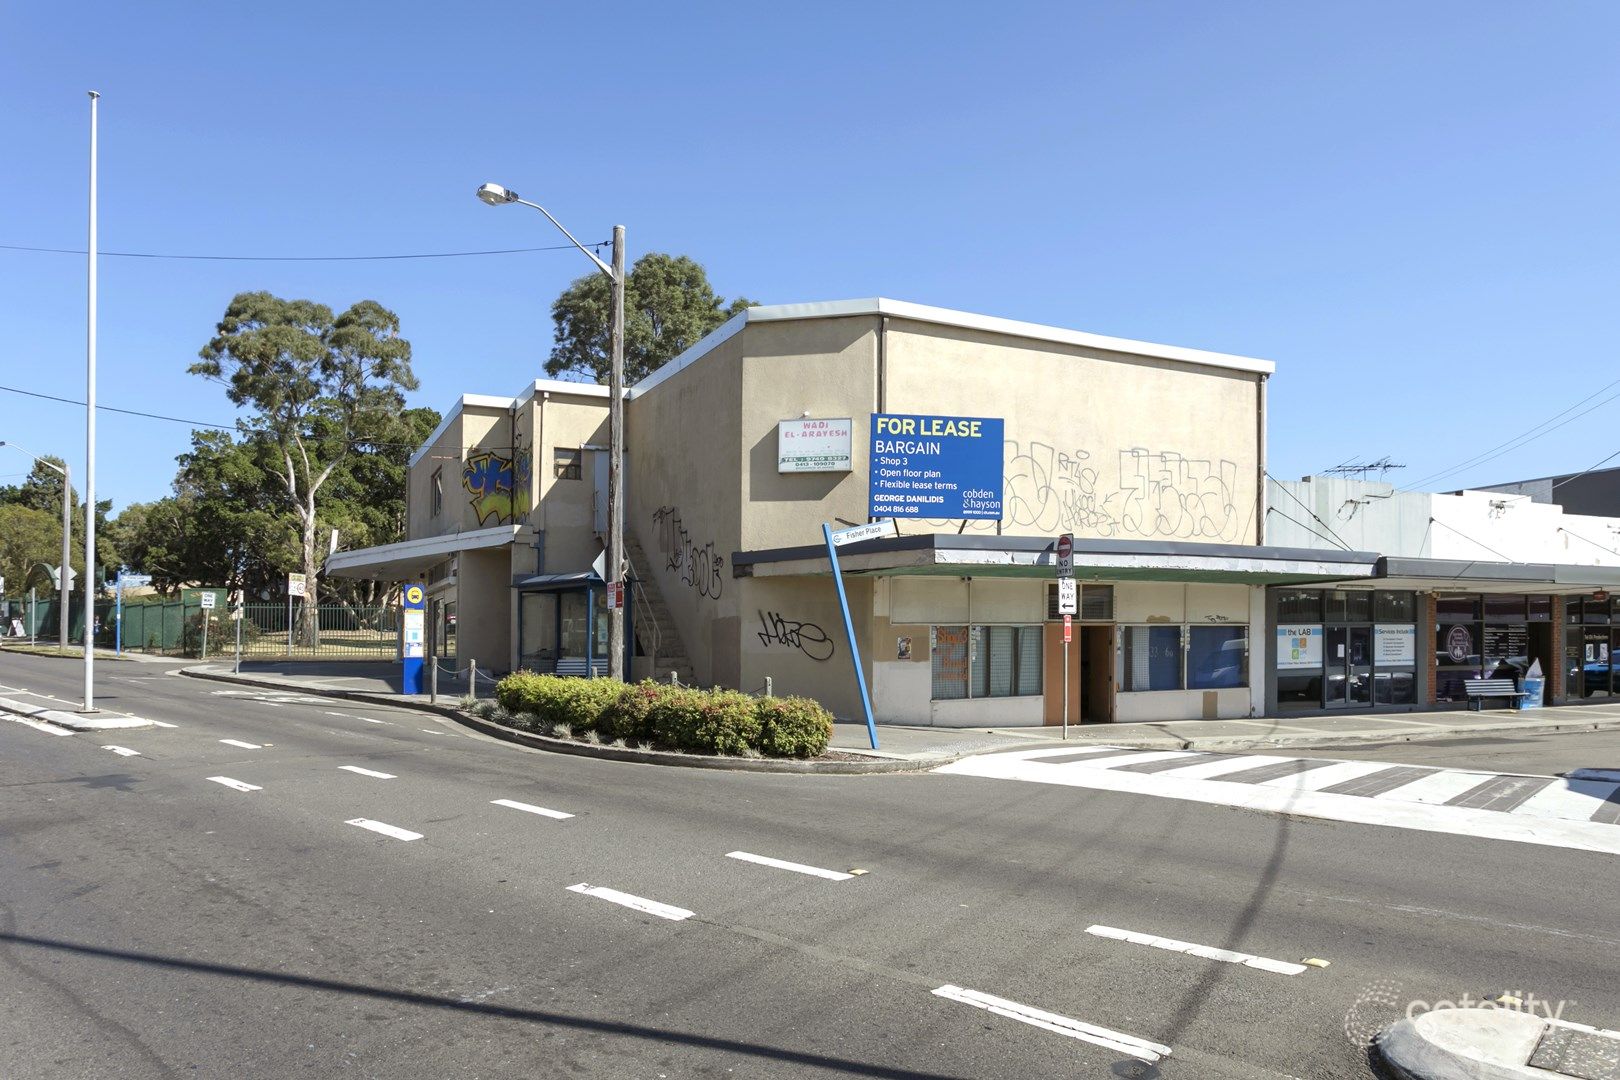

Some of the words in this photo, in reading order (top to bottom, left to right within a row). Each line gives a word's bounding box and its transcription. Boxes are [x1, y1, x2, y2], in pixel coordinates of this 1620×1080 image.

[804, 421, 829, 429] WADI
[877, 418, 916, 435] FOR
[920, 419, 982, 438] LEASE
[875, 440, 940, 455] BARGAIN
[880, 457, 901, 466] Shop
[880, 468, 901, 478] Open
[903, 469, 922, 477] floor
[924, 470, 941, 479] plan
[880, 480, 911, 489] Flexible
[912, 481, 933, 489] lease
[934, 482, 958, 490] terms
[962, 489, 994, 499] cobden
[906, 495, 944, 504] DANILIDIS
[846, 530, 865, 540] Fisher
[866, 526, 882, 535] Place
[1062, 581, 1073, 590] ONE
